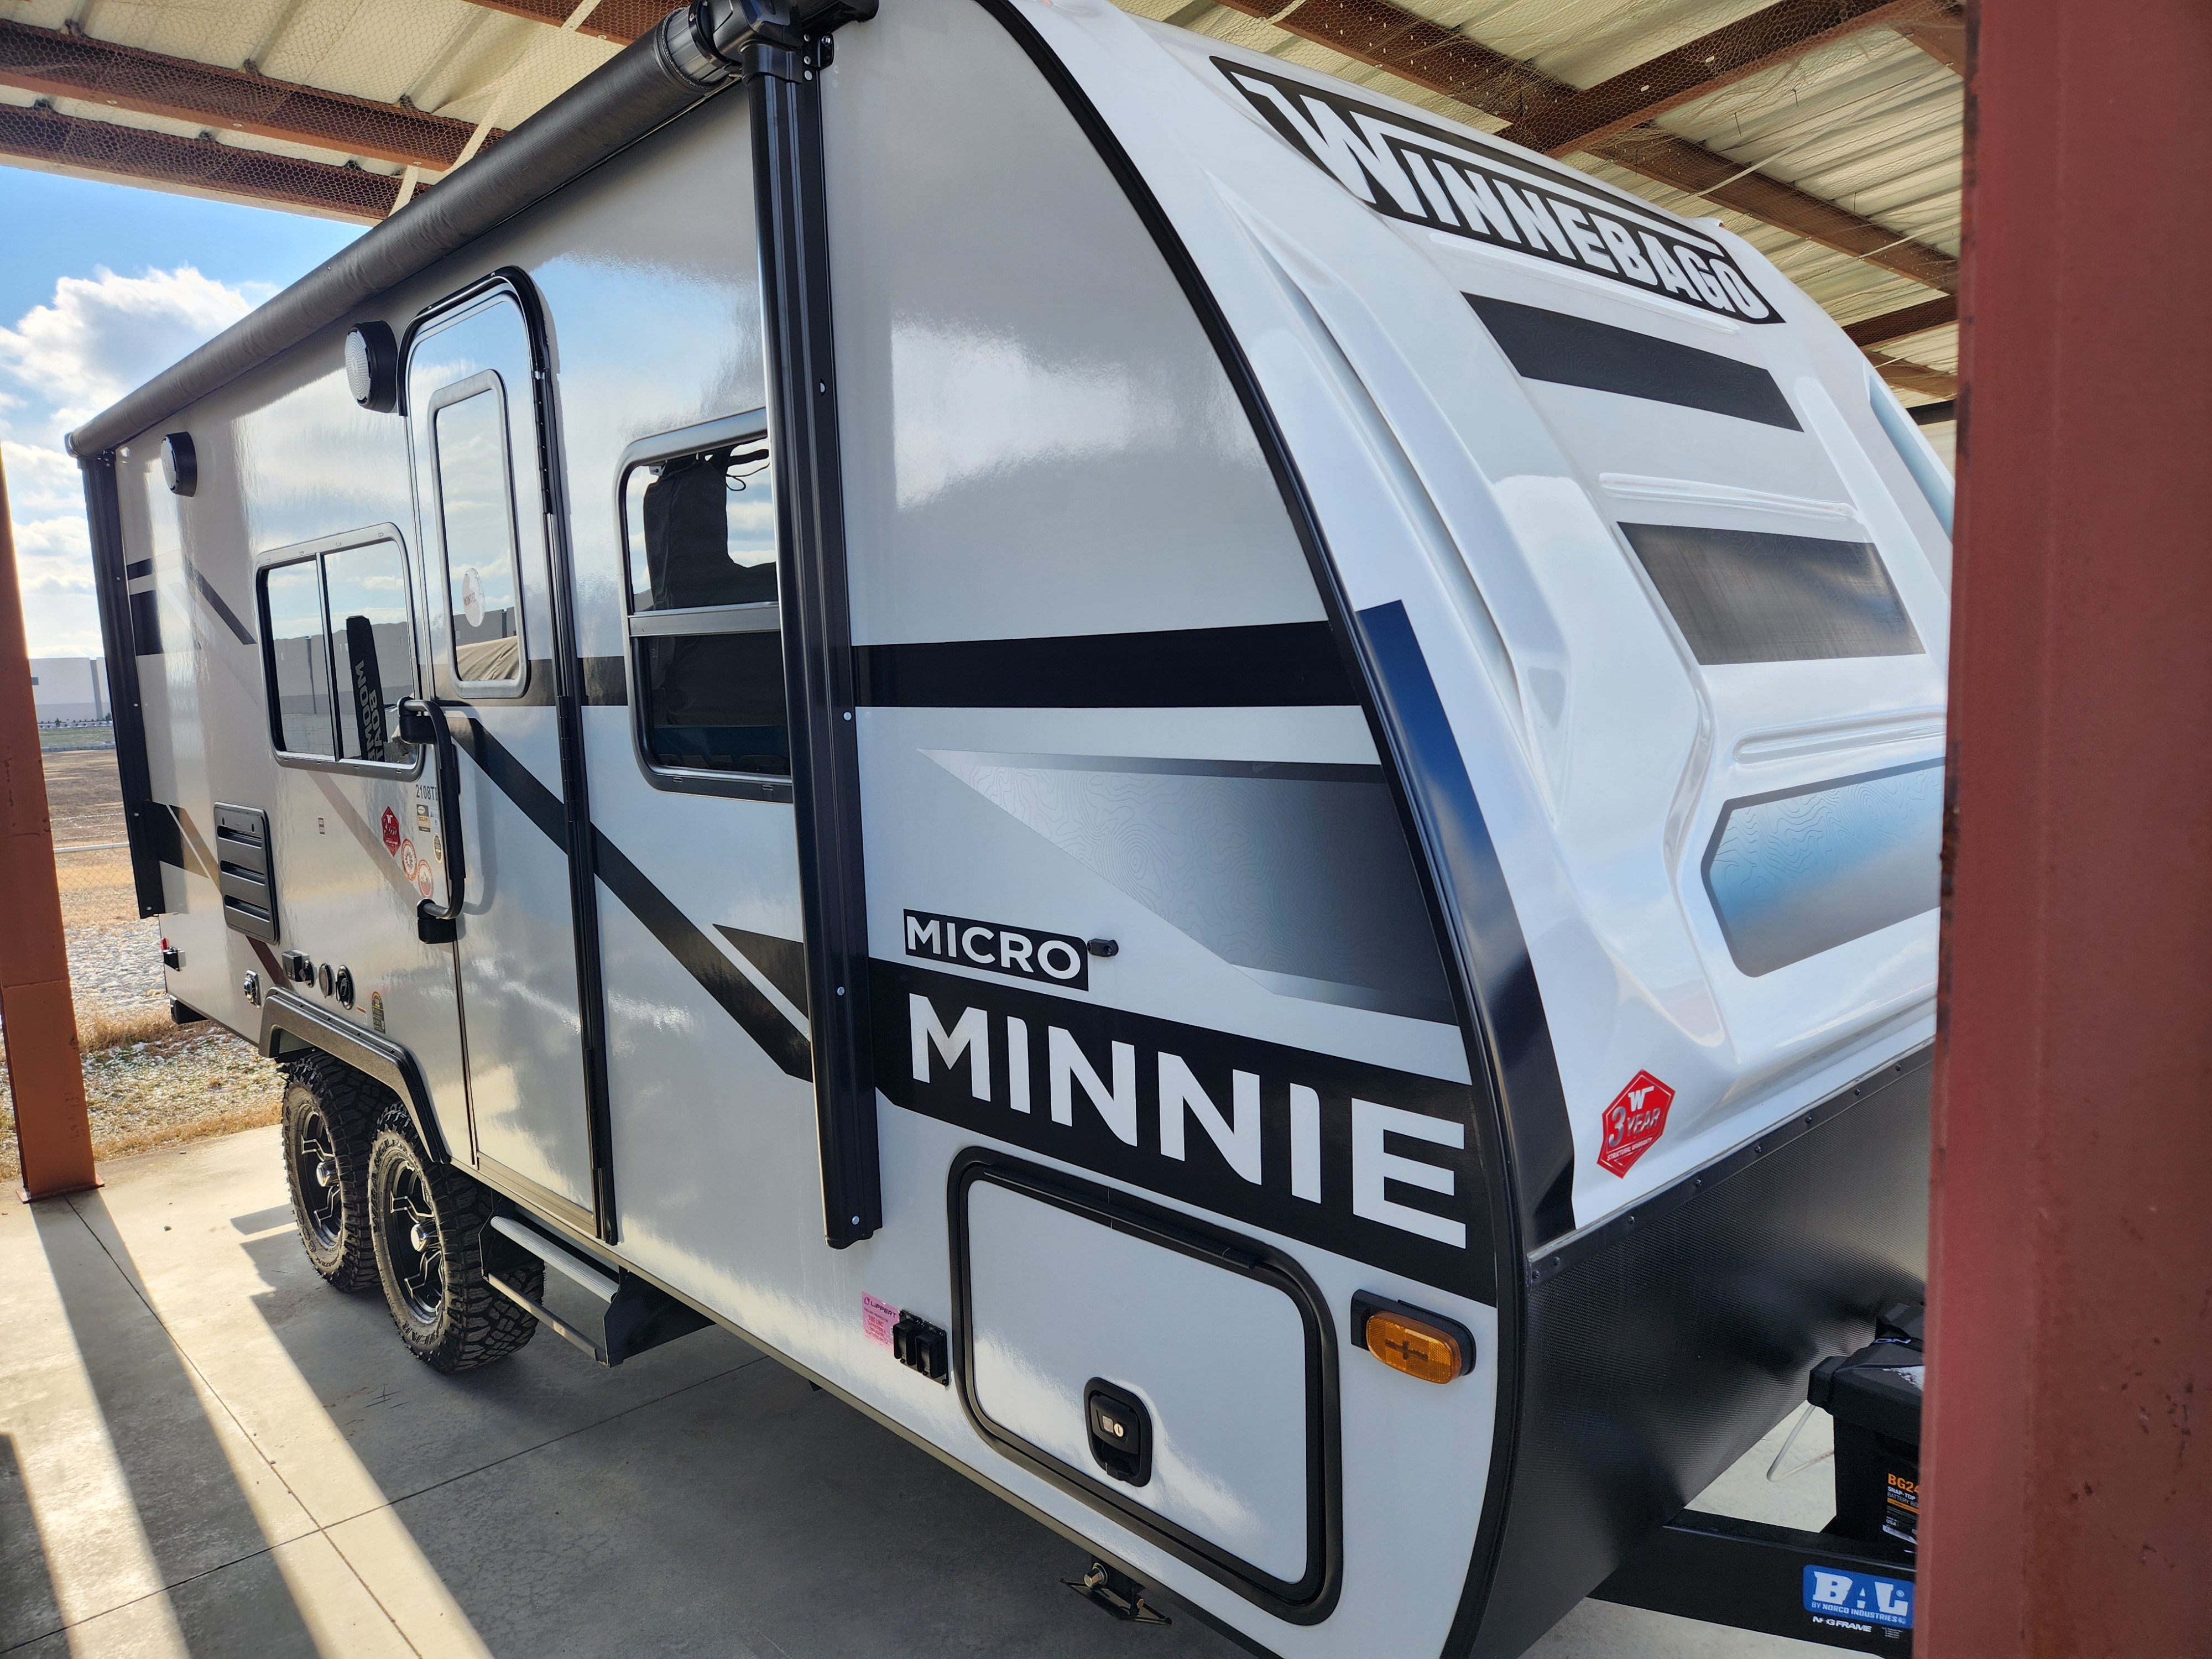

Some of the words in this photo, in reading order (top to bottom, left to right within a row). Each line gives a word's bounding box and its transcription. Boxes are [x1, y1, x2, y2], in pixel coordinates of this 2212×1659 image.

[1231, 72, 1770, 320] WINNEBAGO
[906, 916, 1081, 979] MICRO
[909, 993, 1466, 1249] MINNIE
[1608, 1107, 1626, 1147] 3
[1627, 1108, 1661, 1136] YEAR
[1887, 1492, 1909, 1505] BATTERY
[1822, 1604, 1849, 1614] NORCO
[1851, 1609, 1897, 1623] INDUSTRIES
[1835, 1621, 1872, 1632] FRAME
